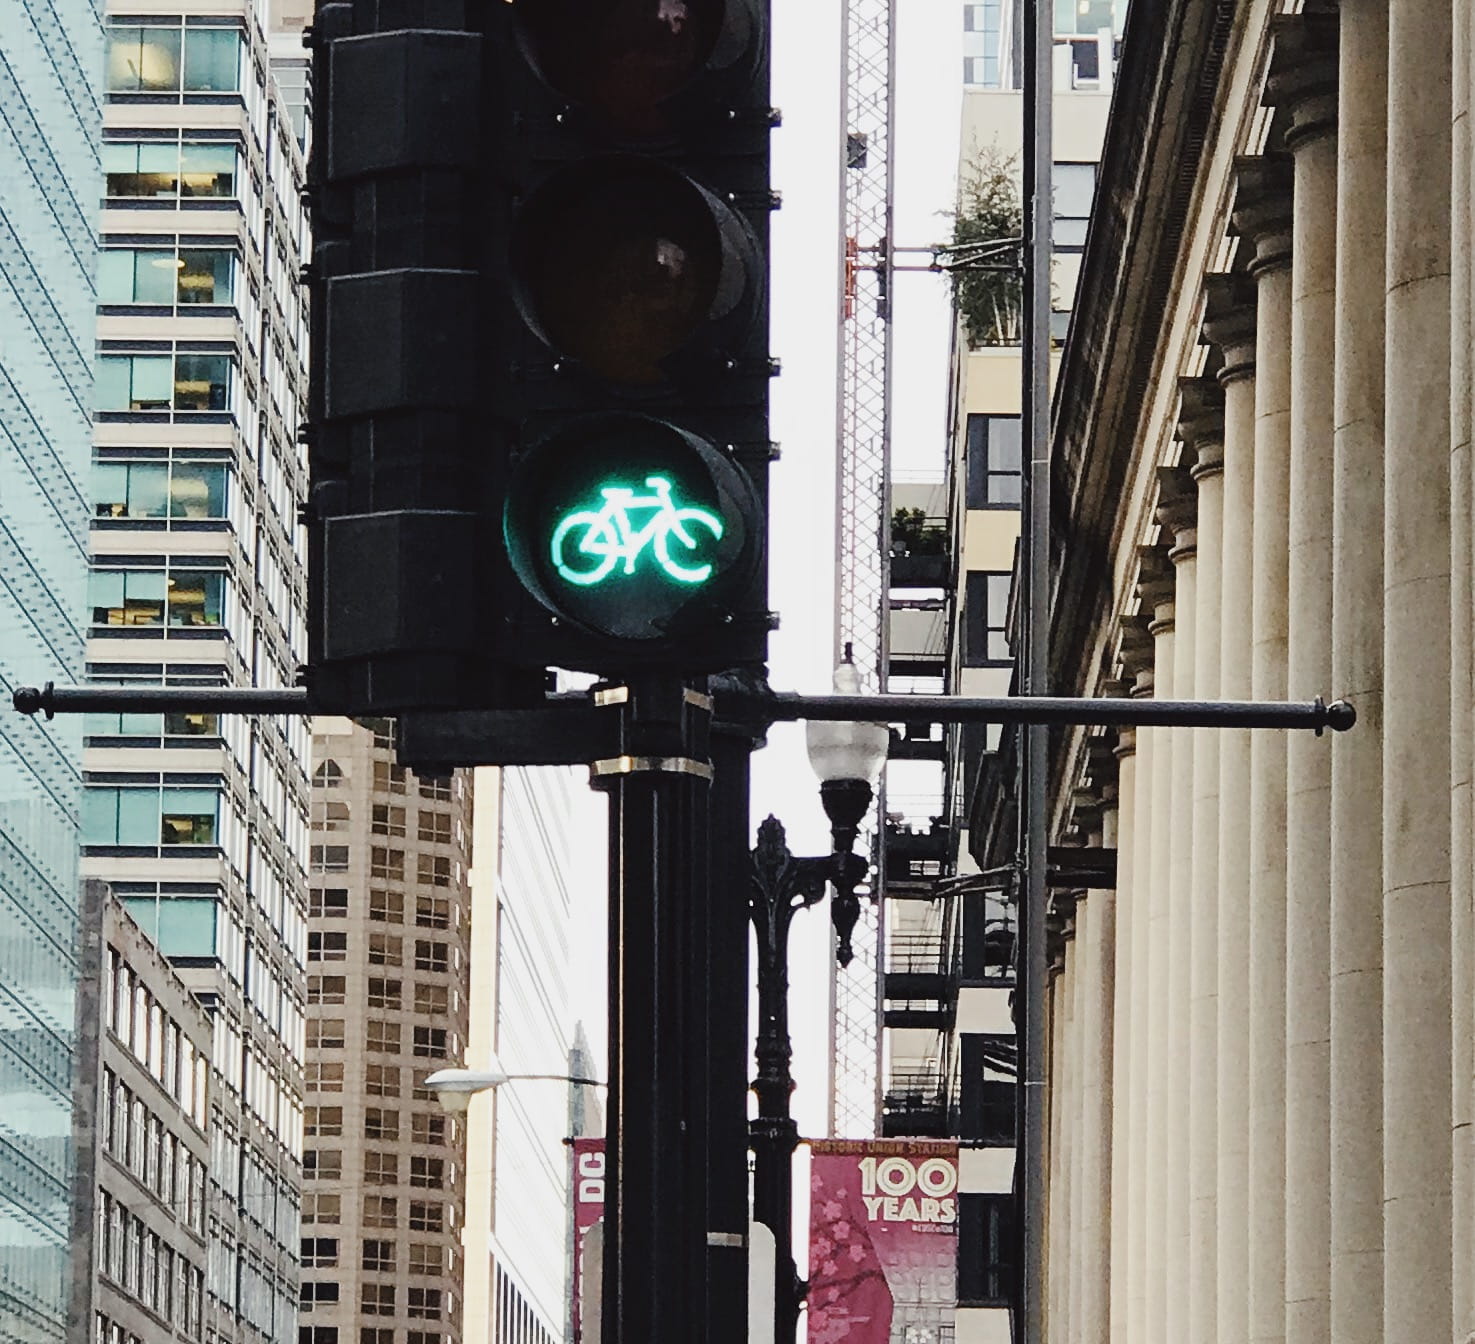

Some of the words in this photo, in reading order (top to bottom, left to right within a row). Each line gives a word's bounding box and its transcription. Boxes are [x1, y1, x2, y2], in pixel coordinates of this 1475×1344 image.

[867, 1142, 904, 1153] UNION
[908, 1143, 957, 1155] STATION
[579, 1152, 606, 1203] DC
[858, 1157, 957, 1197] 100
[862, 1197, 956, 1223] YEARS
